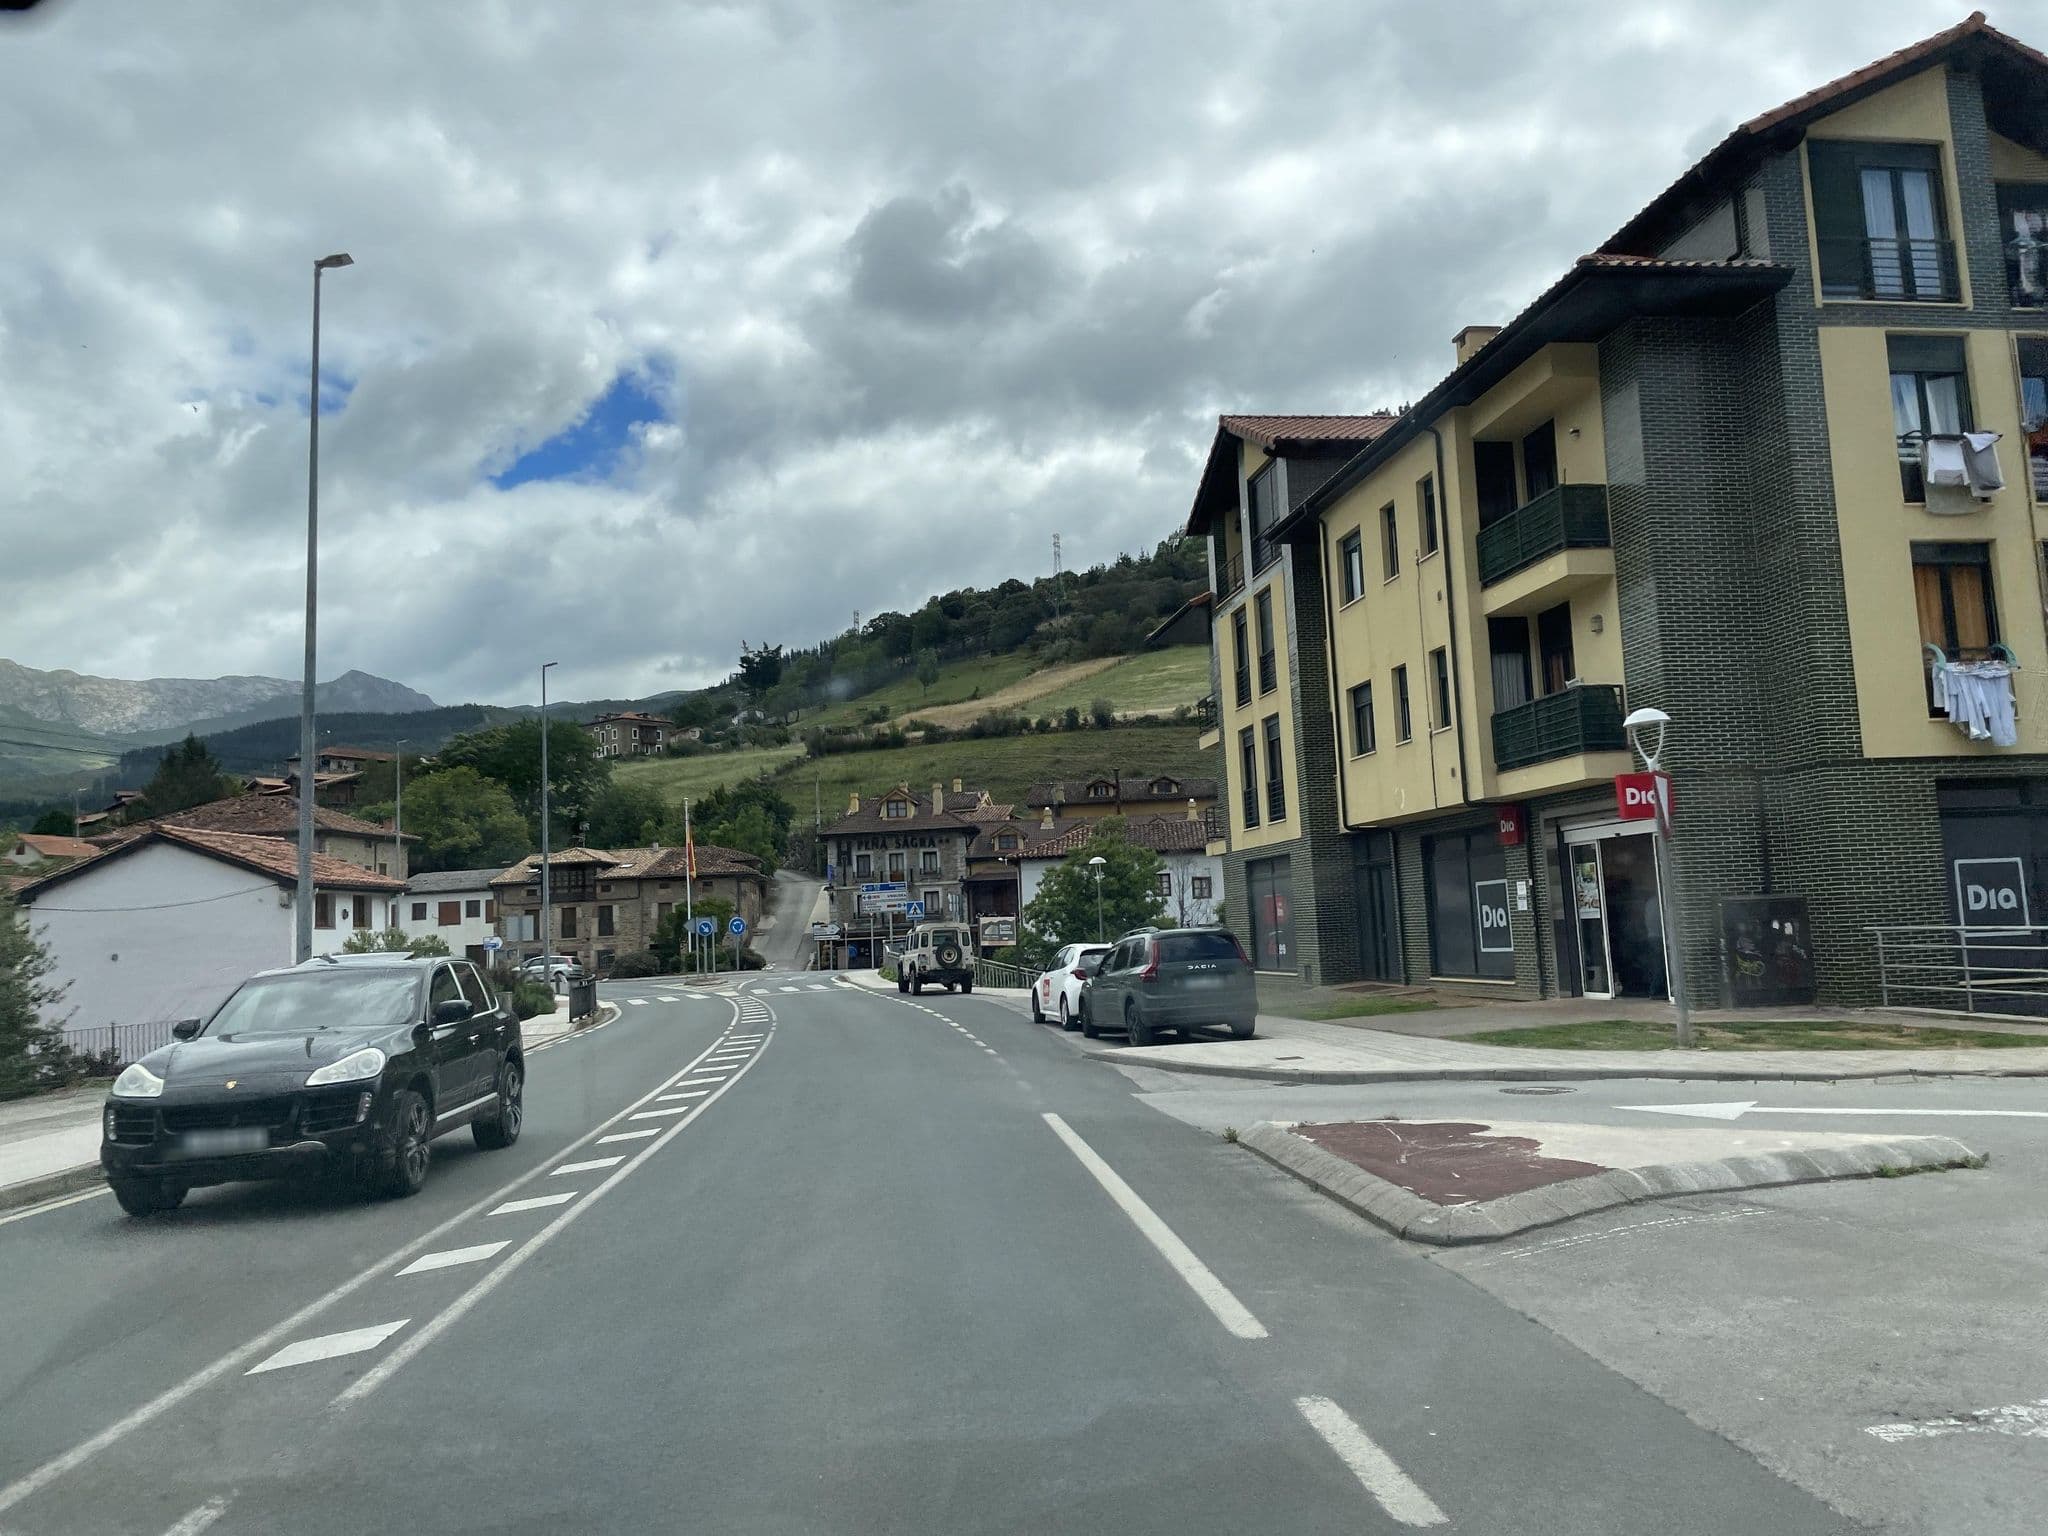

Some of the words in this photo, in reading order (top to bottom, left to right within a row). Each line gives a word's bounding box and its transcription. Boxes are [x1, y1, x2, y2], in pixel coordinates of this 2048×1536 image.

[1500, 820, 1515, 833] Dia
[1966, 885, 2018, 910] Dia
[1481, 904, 1507, 928] Dia
